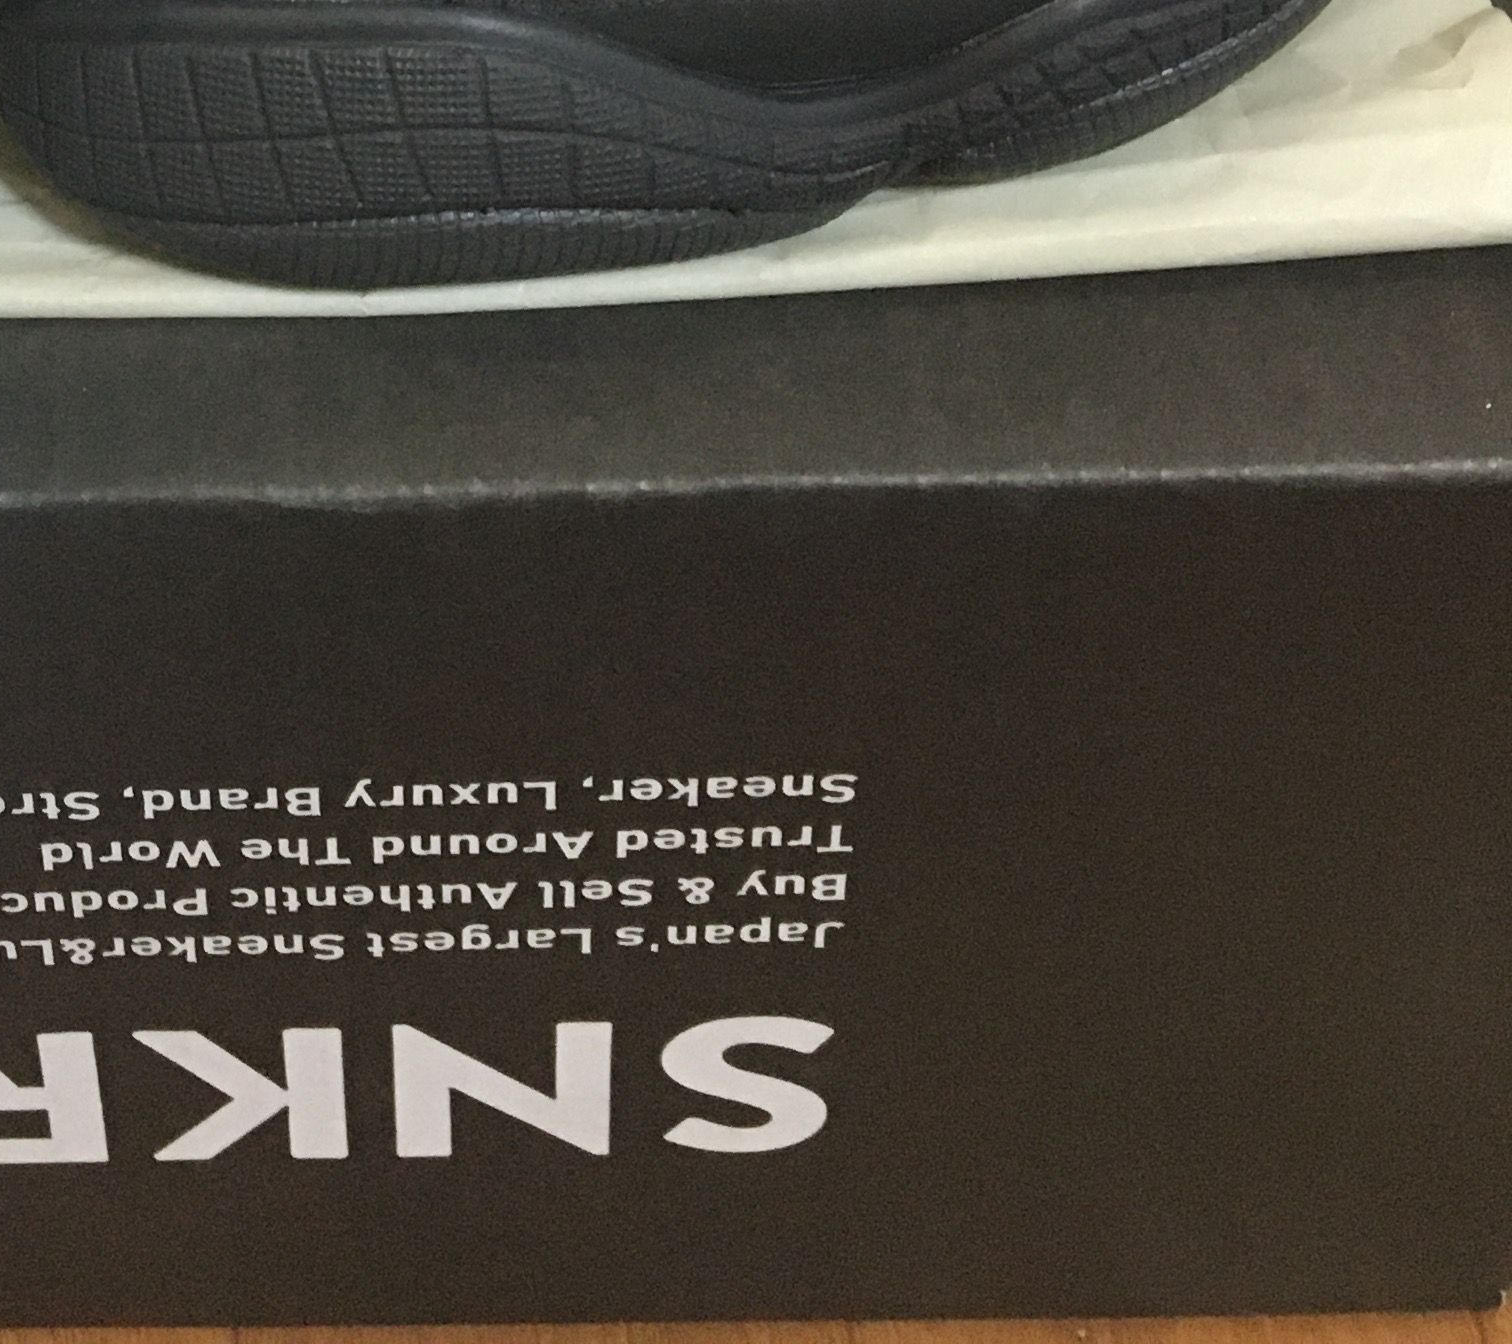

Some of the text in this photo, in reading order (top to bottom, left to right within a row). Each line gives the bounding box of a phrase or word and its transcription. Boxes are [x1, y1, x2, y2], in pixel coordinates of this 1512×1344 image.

[123, 785, 322, 819] Brand,
[344, 778, 557, 811] Luxury
[582, 773, 859, 808] Sneaker,
[40, 824, 854, 872] Trusted Around The World
[230, 880, 518, 913] Authentic
[537, 878, 654, 910] Sell
[677, 876, 715, 905] &
[736, 869, 848, 902] Buy
[366, 923, 592, 958] Largest
[615, 916, 846, 953] Japan's
